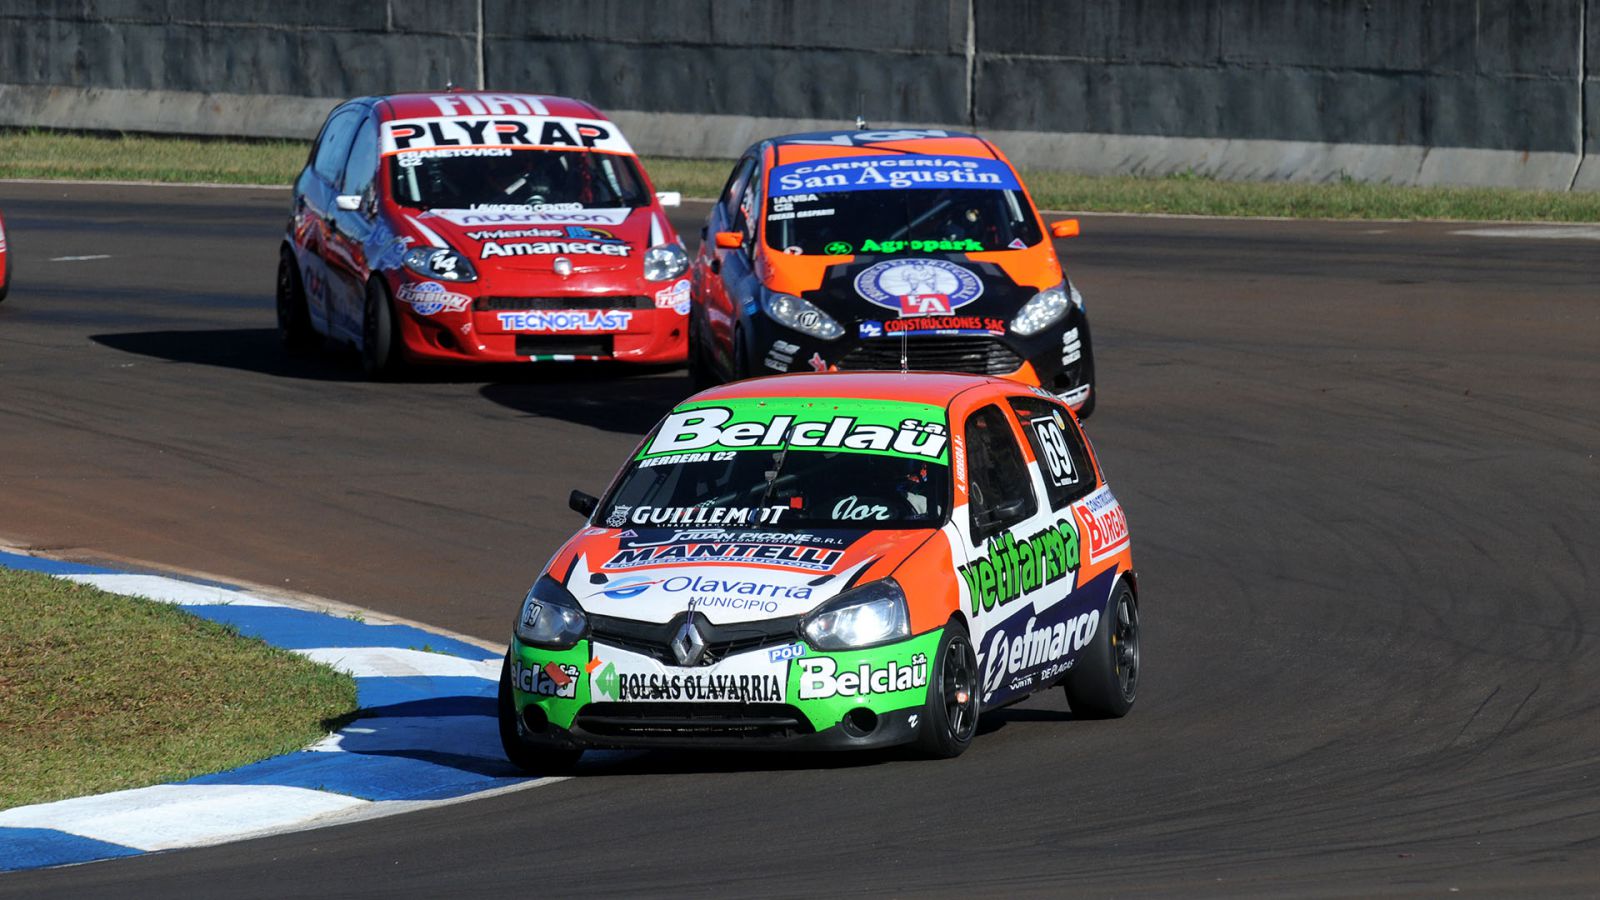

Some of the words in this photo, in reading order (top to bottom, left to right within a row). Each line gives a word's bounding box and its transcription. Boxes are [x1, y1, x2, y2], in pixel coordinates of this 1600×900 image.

[430, 95, 550, 116] FIAT
[391, 120, 610, 149] PLYRAP
[399, 159, 423, 168] C2
[795, 159, 979, 174] CARNICERÍAS
[780, 172, 848, 191] San
[855, 166, 1002, 188] Agustin
[466, 228, 564, 240] Viviendas
[481, 242, 631, 259] Amanecer
[860, 239, 985, 254] Agropark
[432, 254, 458, 272] 14
[498, 312, 632, 331] TECNOPLAST
[884, 318, 982, 332] CONSTRUCCIONES
[1037, 421, 1073, 478] 69
[638, 453, 709, 469] HERRERA
[712, 451, 737, 461] C2
[631, 505, 790, 524] GUILLEMOT
[607, 544, 845, 567] MANTELLI
[957, 518, 1081, 618] vetifarma
[689, 596, 779, 613] MUNICIPIO
[525, 603, 541, 626] 69
[771, 645, 804, 661] POU
[618, 673, 682, 701] BOLSAS
[683, 674, 782, 702] OLAVARRIA
